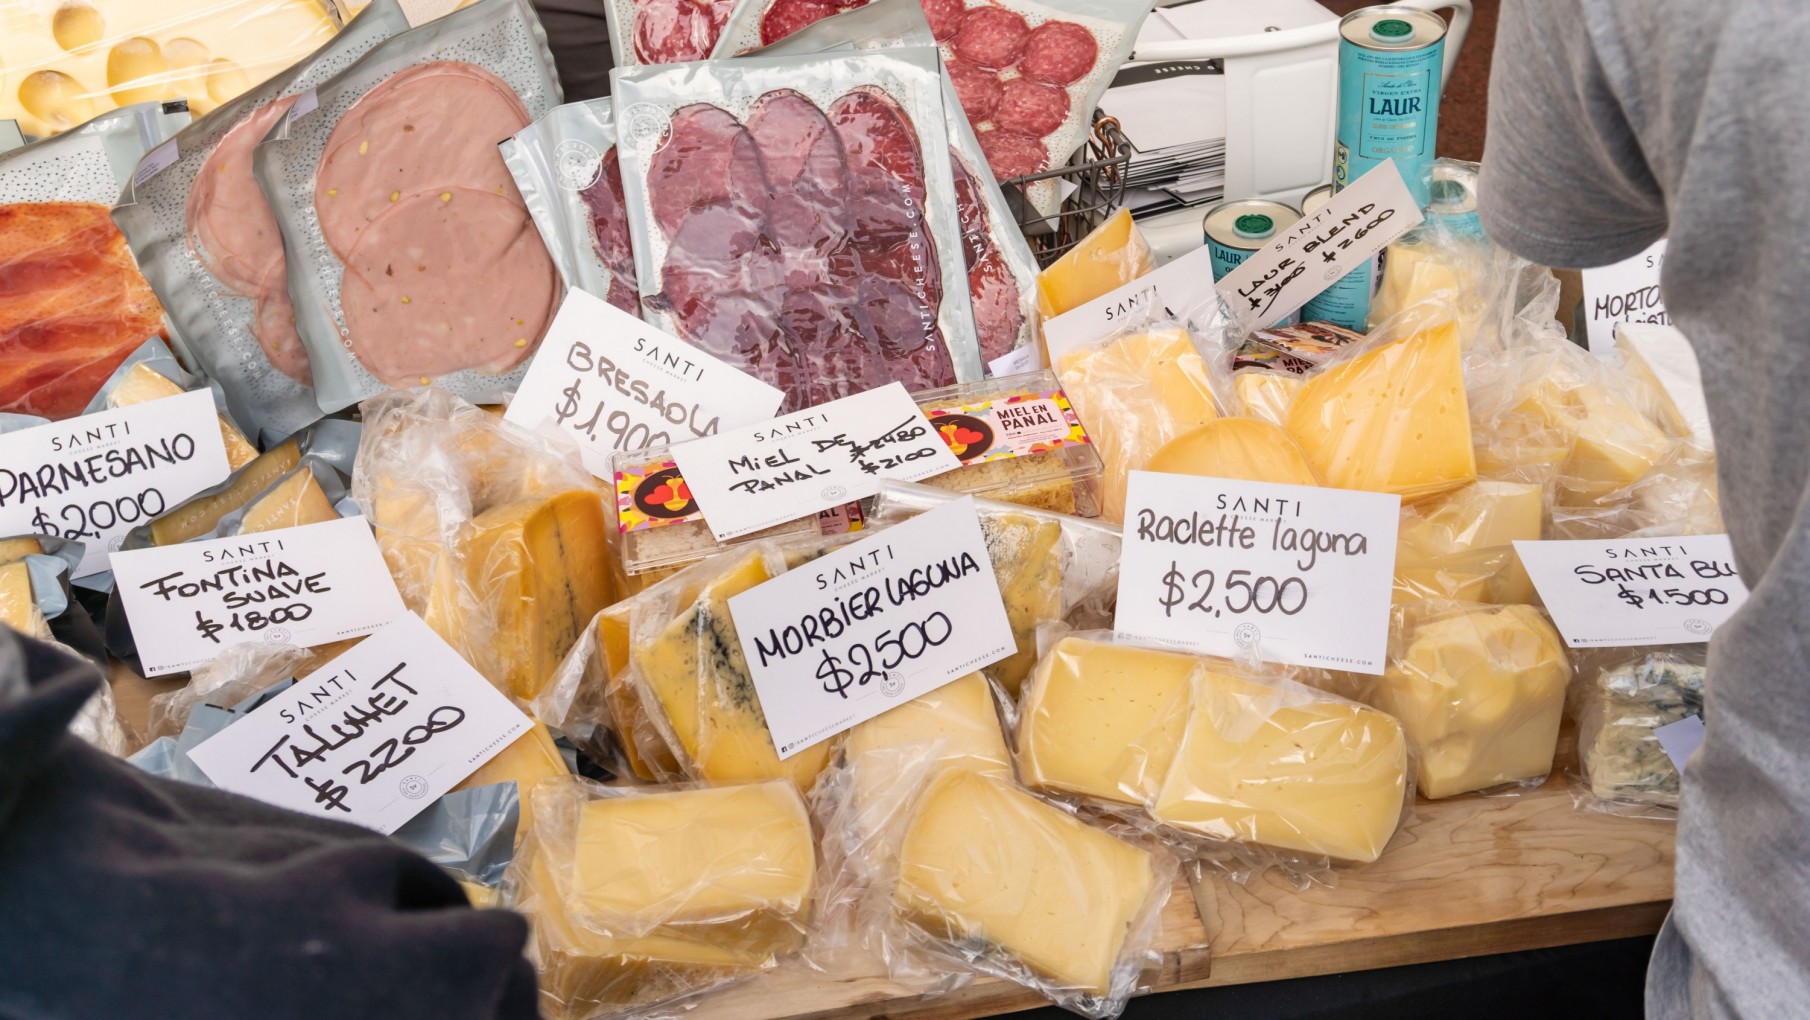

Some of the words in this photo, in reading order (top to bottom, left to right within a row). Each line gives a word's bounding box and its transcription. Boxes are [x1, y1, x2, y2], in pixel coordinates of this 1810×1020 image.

[1369, 96, 1422, 116] LAUR
[1276, 208, 1332, 252] SANTI
[1215, 246, 1242, 265] LAUR
[1238, 257, 1295, 298] LAUR
[1303, 203, 1376, 254] BLEND
[902, 184, 936, 352] SANTICHEESE.COM
[1105, 285, 1157, 321] SANTI
[1594, 284, 1662, 321] MORTO
[633, 338, 704, 382] SANTI
[567, 341, 720, 438] BRESAOLA
[754, 413, 829, 442] SANTI
[996, 406, 1030, 420] MIEL
[1032, 404, 1048, 414] EN
[1001, 413, 1058, 431] PANAL
[52, 421, 130, 452] SANTI
[812, 434, 852, 452] DE
[0, 433, 196, 507] PARMESANO
[729, 464, 831, 494] PANAL
[1217, 494, 1300, 517] SANTI
[1260, 517, 1288, 525] MART
[203, 540, 284, 563] SANTI
[1137, 508, 1256, 549] Raclette
[1272, 517, 1367, 571] laguna
[1605, 546, 1687, 559] SANTI
[817, 545, 894, 590] SANTI
[886, 552, 981, 605] LAGUNA
[1574, 563, 1685, 585] SANTA
[223, 572, 331, 609] SUAVE
[1158, 560, 1308, 618] $2,500
[1304, 653, 1373, 666] SANTICHEESE.COM
[280, 669, 357, 724] SANTI
